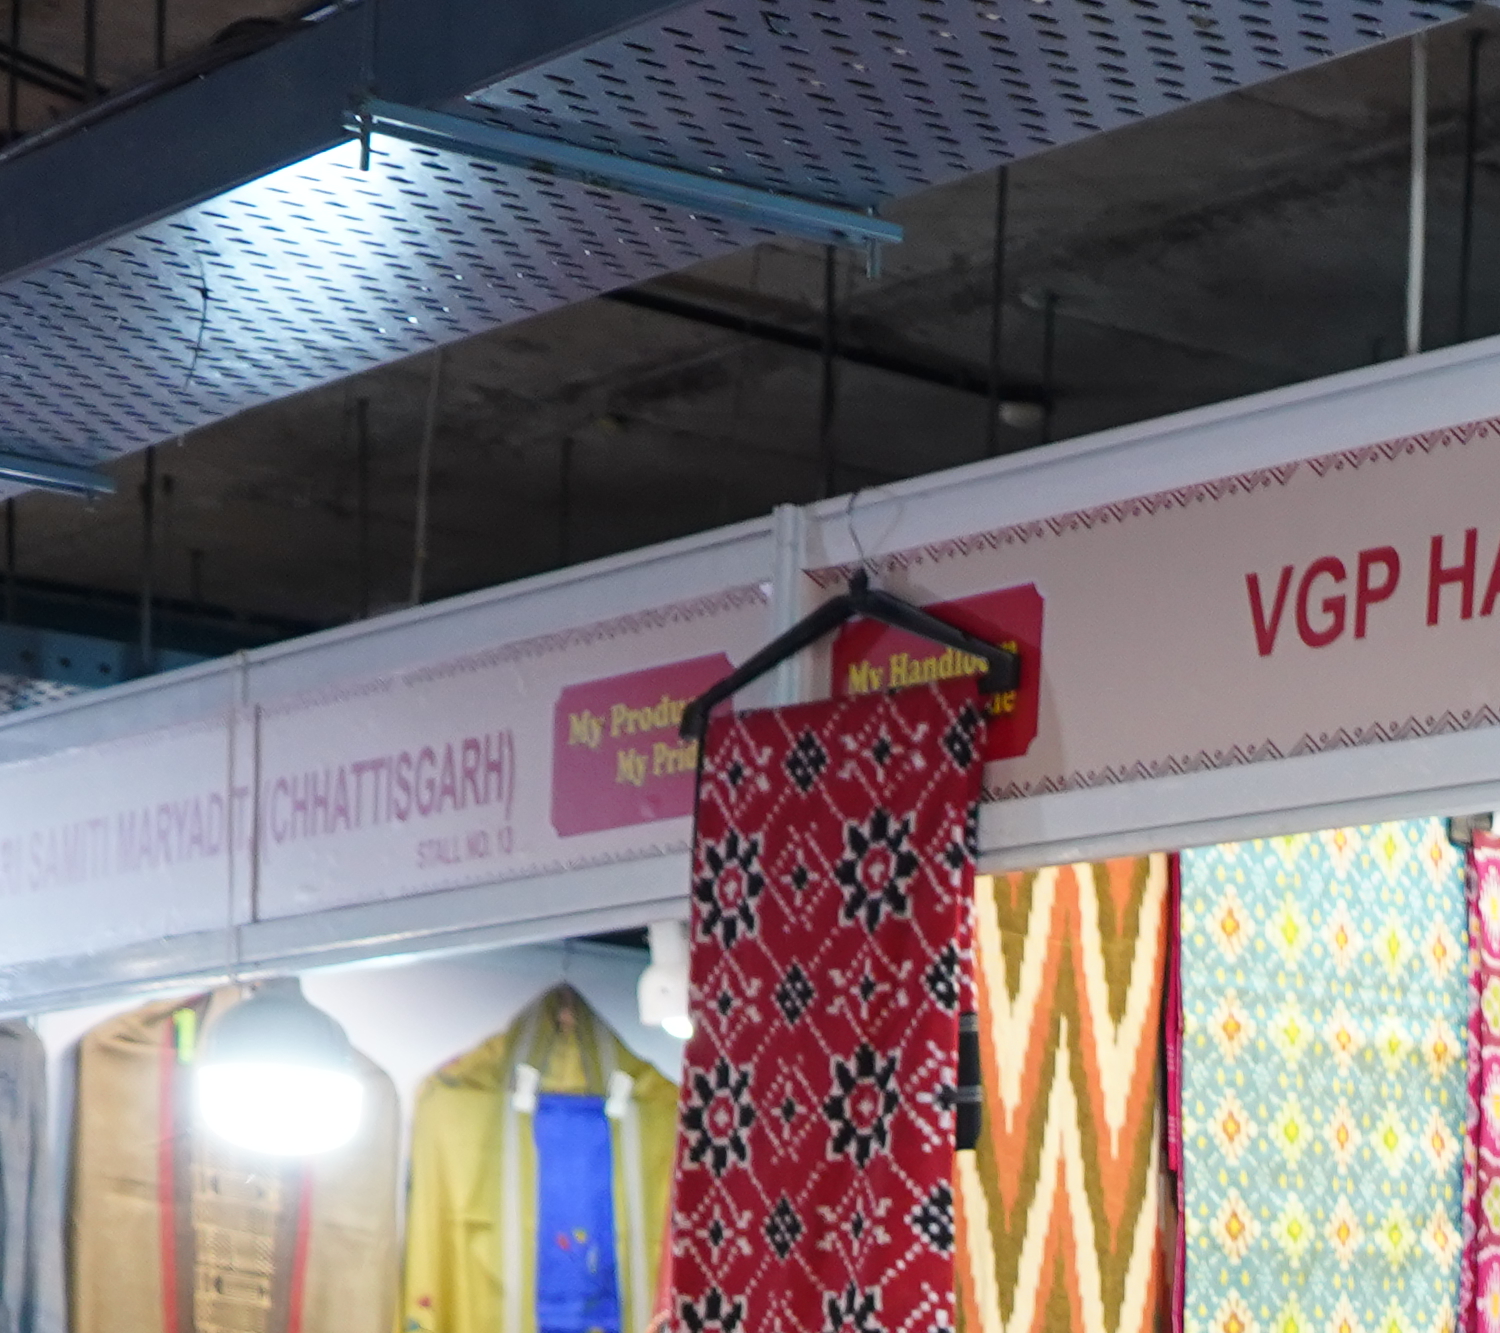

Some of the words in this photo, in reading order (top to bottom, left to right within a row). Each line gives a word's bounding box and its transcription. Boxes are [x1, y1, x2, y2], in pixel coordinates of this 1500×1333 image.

[1245, 537, 1402, 657] VGP
[848, 659, 884, 694] My
[568, 709, 605, 750] My
[609, 693, 689, 738] Produ
[616, 748, 648, 787] My
[652, 739, 698, 776] Prid
[264, 728, 516, 864] (CHHATTISGARH)
